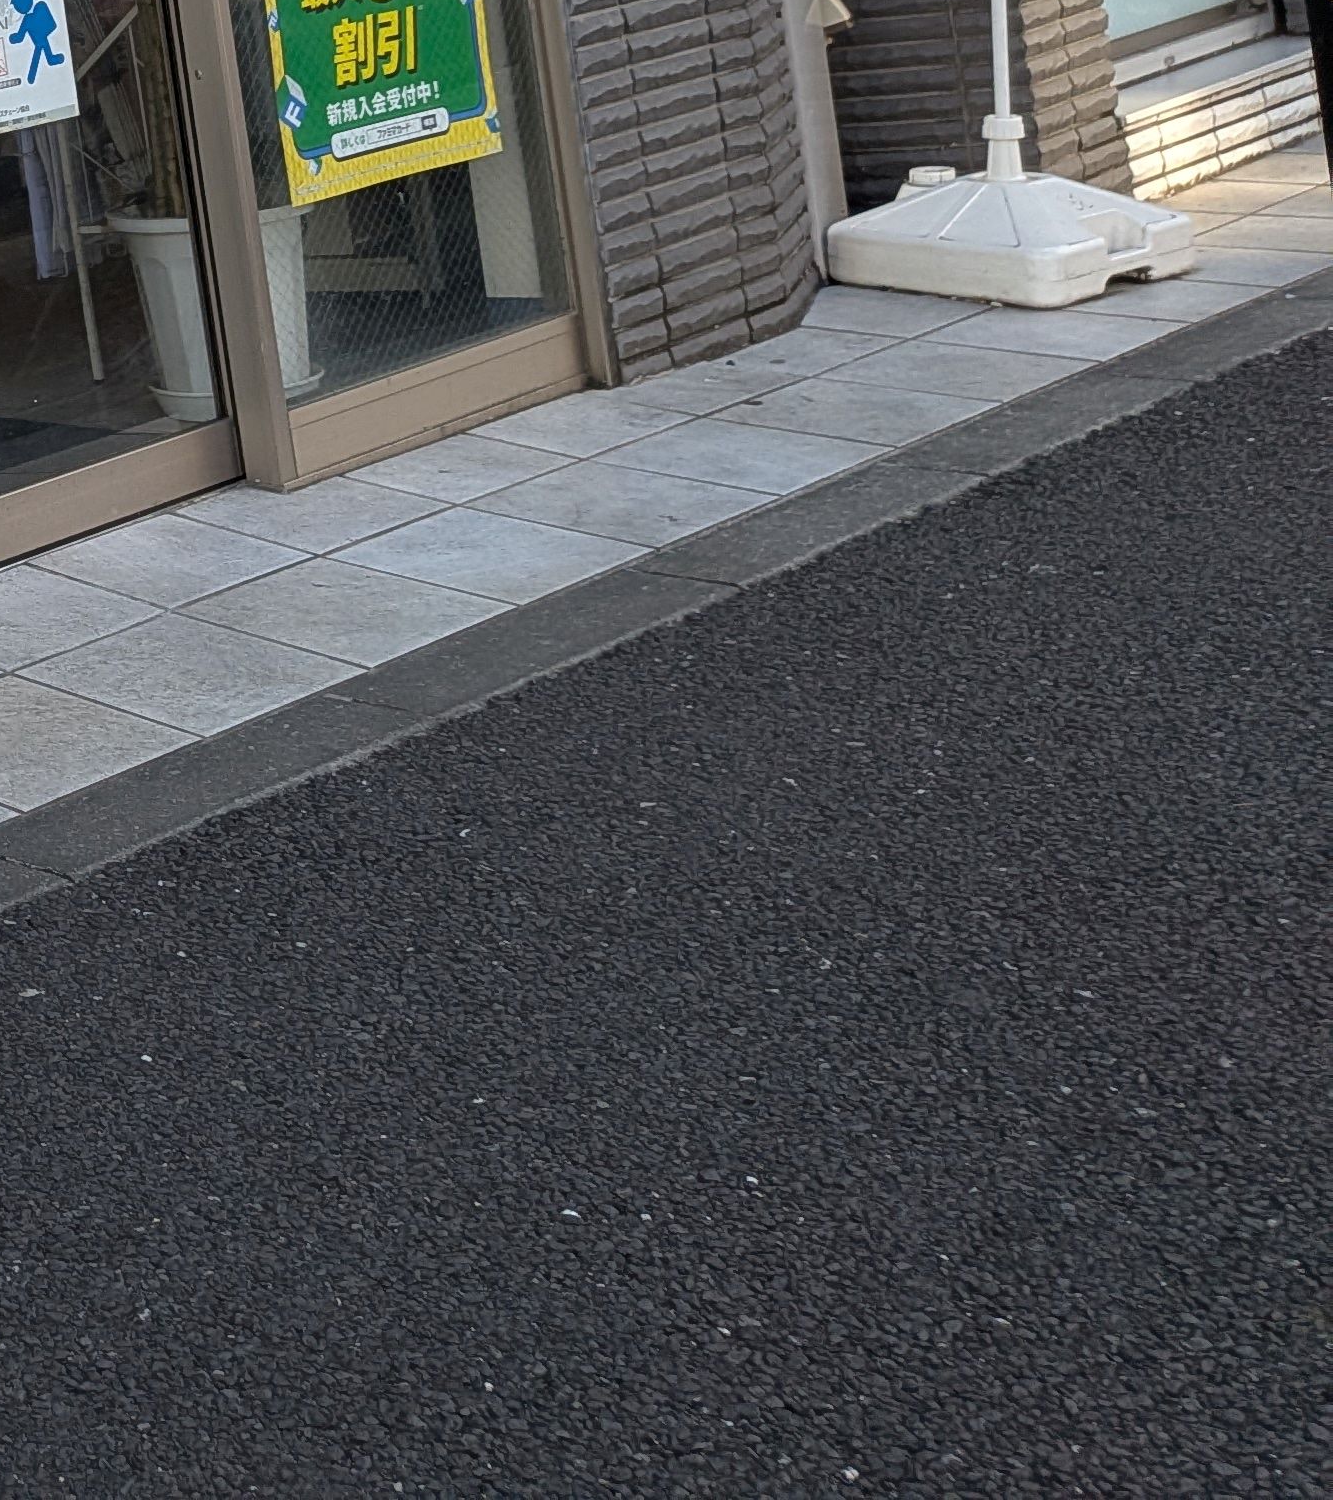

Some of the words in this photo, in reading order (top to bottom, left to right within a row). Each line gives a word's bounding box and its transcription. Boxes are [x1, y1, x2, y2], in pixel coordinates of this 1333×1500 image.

[332, 4, 416, 88] 割引
[325, 79, 441, 128] 新規入会受付中!
